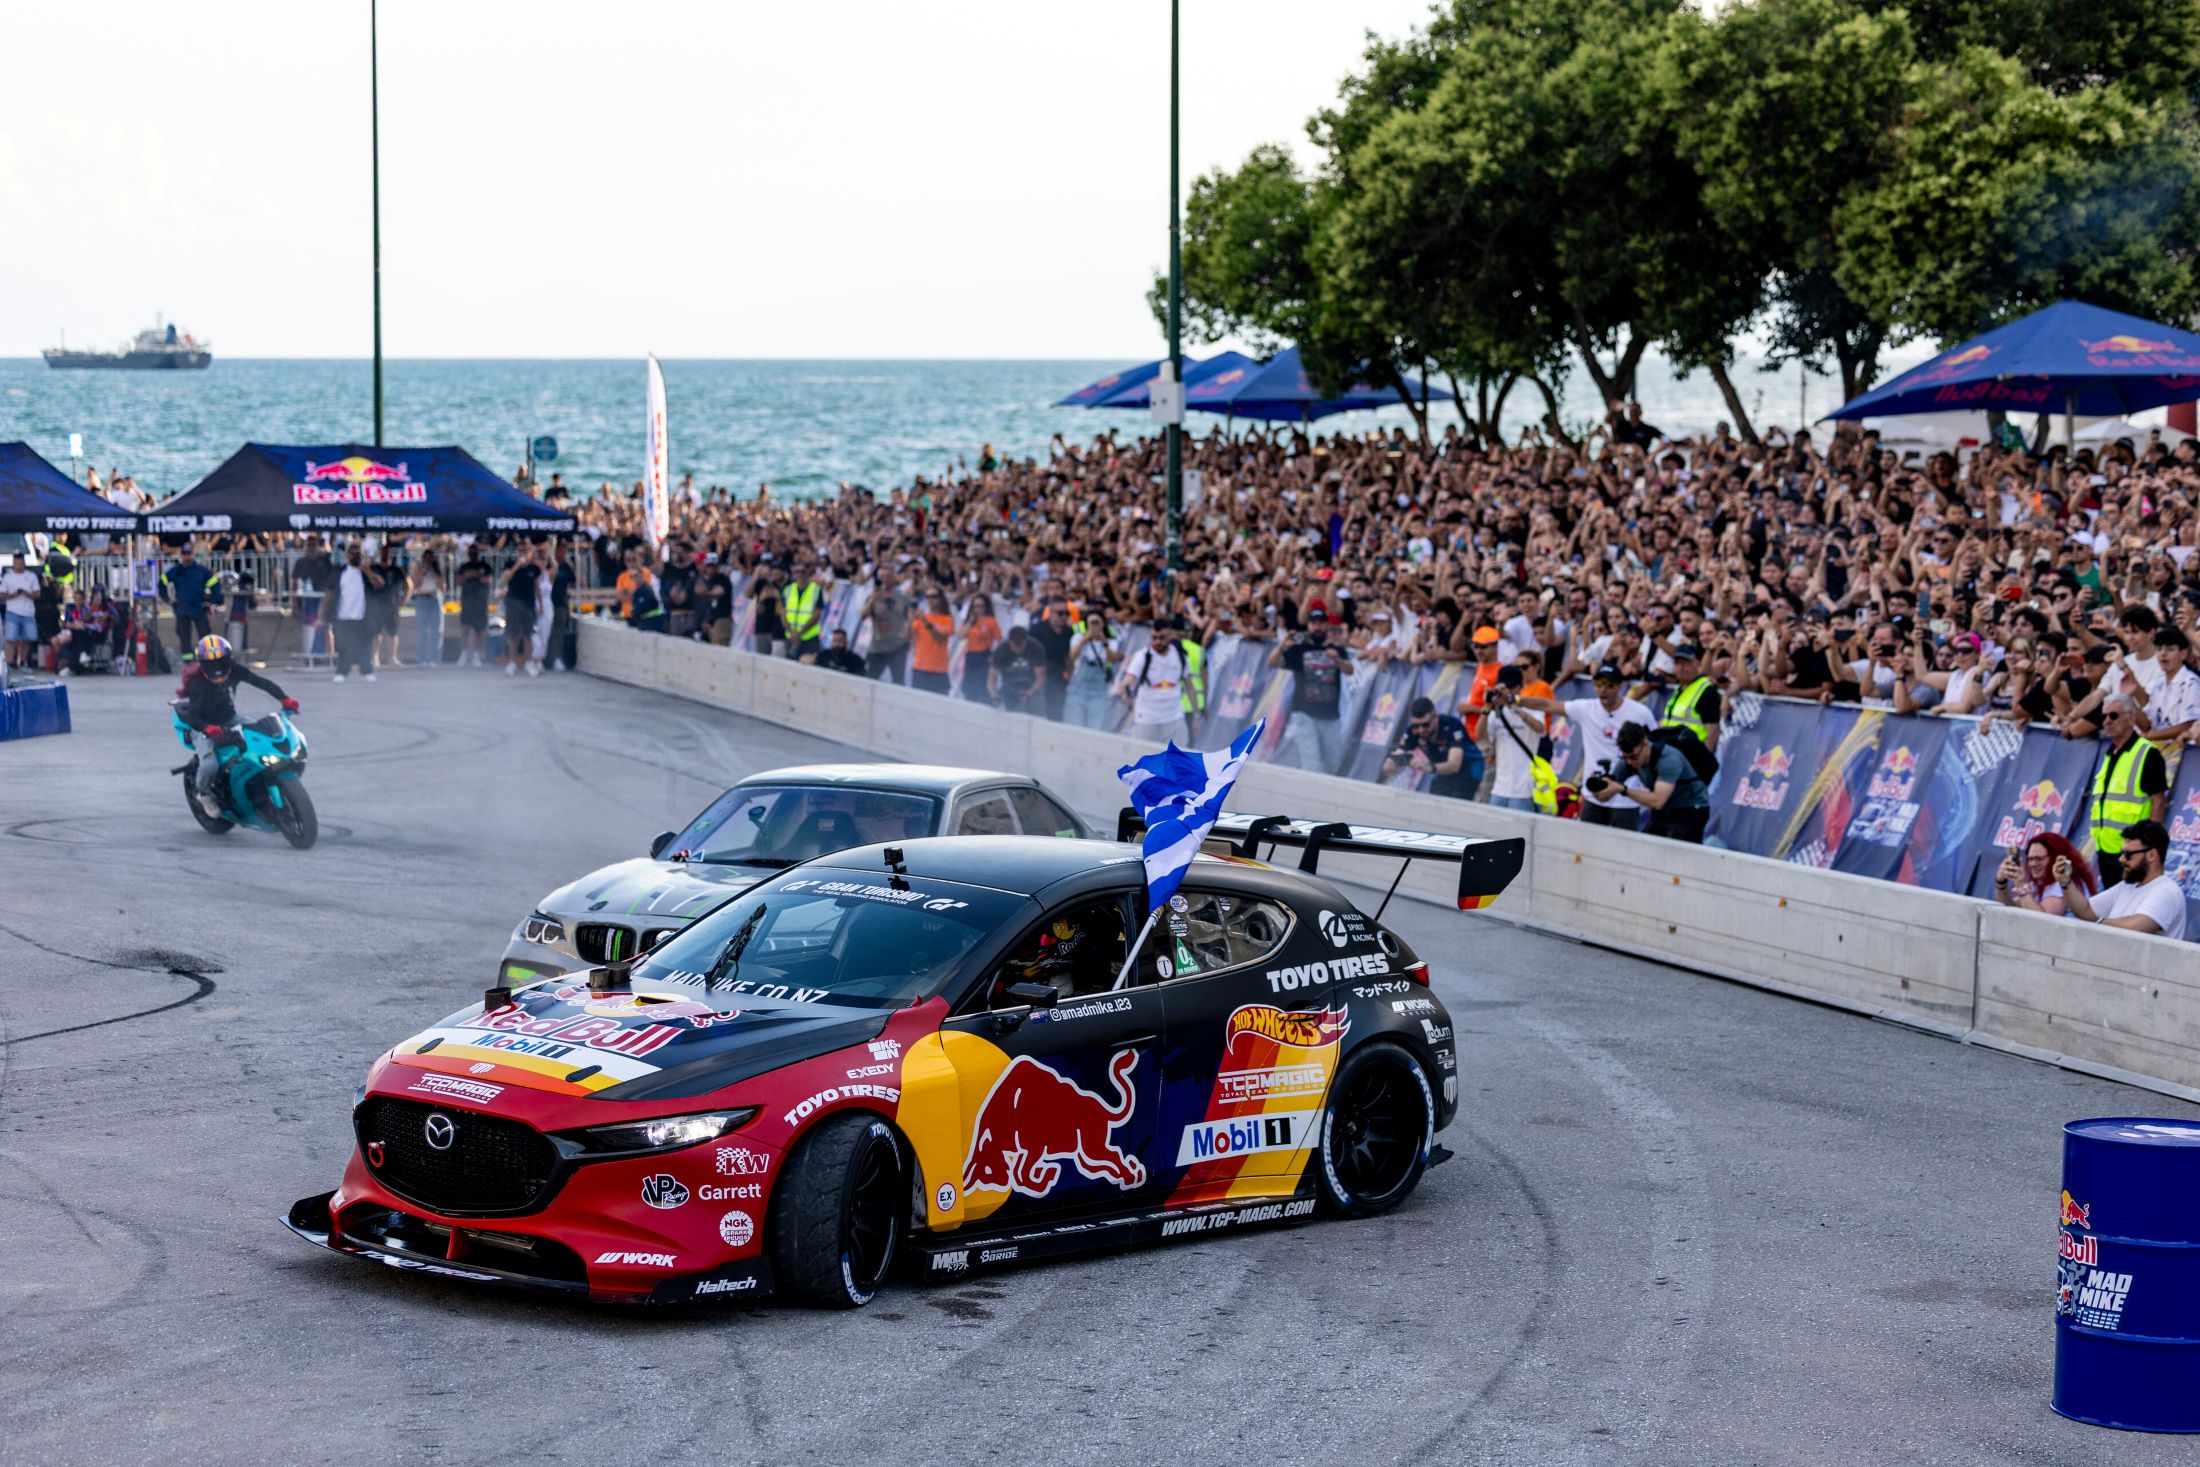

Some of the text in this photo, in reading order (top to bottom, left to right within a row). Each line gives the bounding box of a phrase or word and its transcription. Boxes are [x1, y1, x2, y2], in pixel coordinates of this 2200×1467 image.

[293, 482, 427, 505] Red Bull
[47, 517, 137, 529] TOYO TIRES
[314, 516, 337, 528] MAD
[1993, 816, 2034, 849] Red
[818, 881, 863, 895] GRAN
[861, 885, 925, 901] TURISMO
[1342, 913, 1364, 921] MAZDA
[1347, 923, 1365, 931] SPIRIT
[1352, 934, 1375, 942] RACING
[1266, 952, 1390, 993] TOYO TIRES
[1353, 980, 1410, 998] マッドマイク
[1403, 999, 1436, 1010] WORK
[455, 1001, 685, 1058] Red Bull
[1233, 1010, 1252, 1032] HOT
[471, 1034, 545, 1054] Mobil
[847, 1063, 894, 1078] EXEDY
[784, 1085, 900, 1127] TOYO TIRES
[872, 1123, 890, 1138] TOYO
[1193, 1120, 1259, 1158] Mobil
[724, 1154, 769, 1175] KW
[643, 1174, 675, 1207] VP
[698, 1183, 761, 1200] Garrett
[940, 1191, 952, 1201] EX
[725, 1219, 747, 1228] NGK
[1161, 1199, 1316, 1236] WWW.TCP-MAGIC.COM
[989, 1250, 1018, 1261] BRIDE
[2063, 1231, 2098, 1266] Bull
[622, 1253, 677, 1268] WORK
[932, 1250, 970, 1269] MAX
[695, 1276, 757, 1294] Haltech
[2087, 1269, 2133, 1293] MAD
[2079, 1287, 2127, 1312] MIKE
